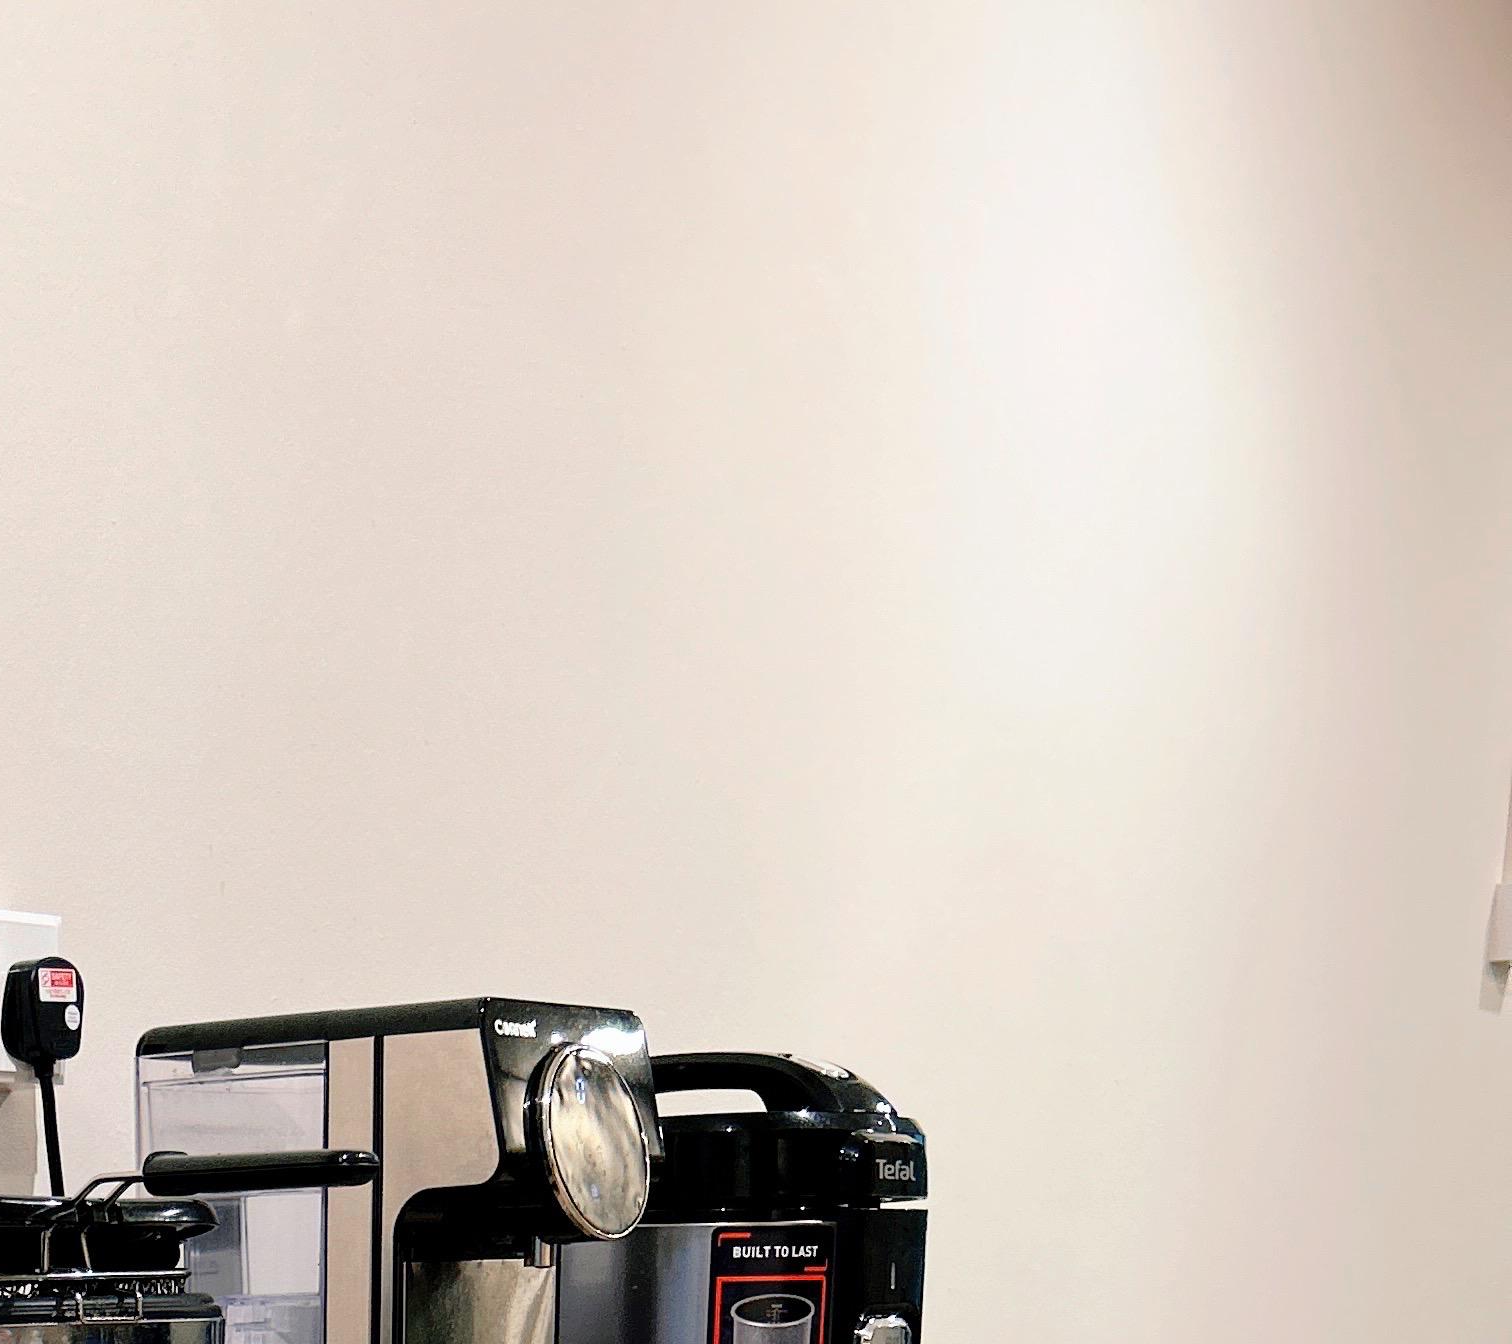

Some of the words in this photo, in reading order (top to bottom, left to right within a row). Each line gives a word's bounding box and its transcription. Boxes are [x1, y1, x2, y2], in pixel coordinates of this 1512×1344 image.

[875, 1158, 917, 1182] Tefal
[732, 1246, 771, 1259] BUILT
[774, 1246, 789, 1258] TO
[791, 1245, 819, 1258] LAST
